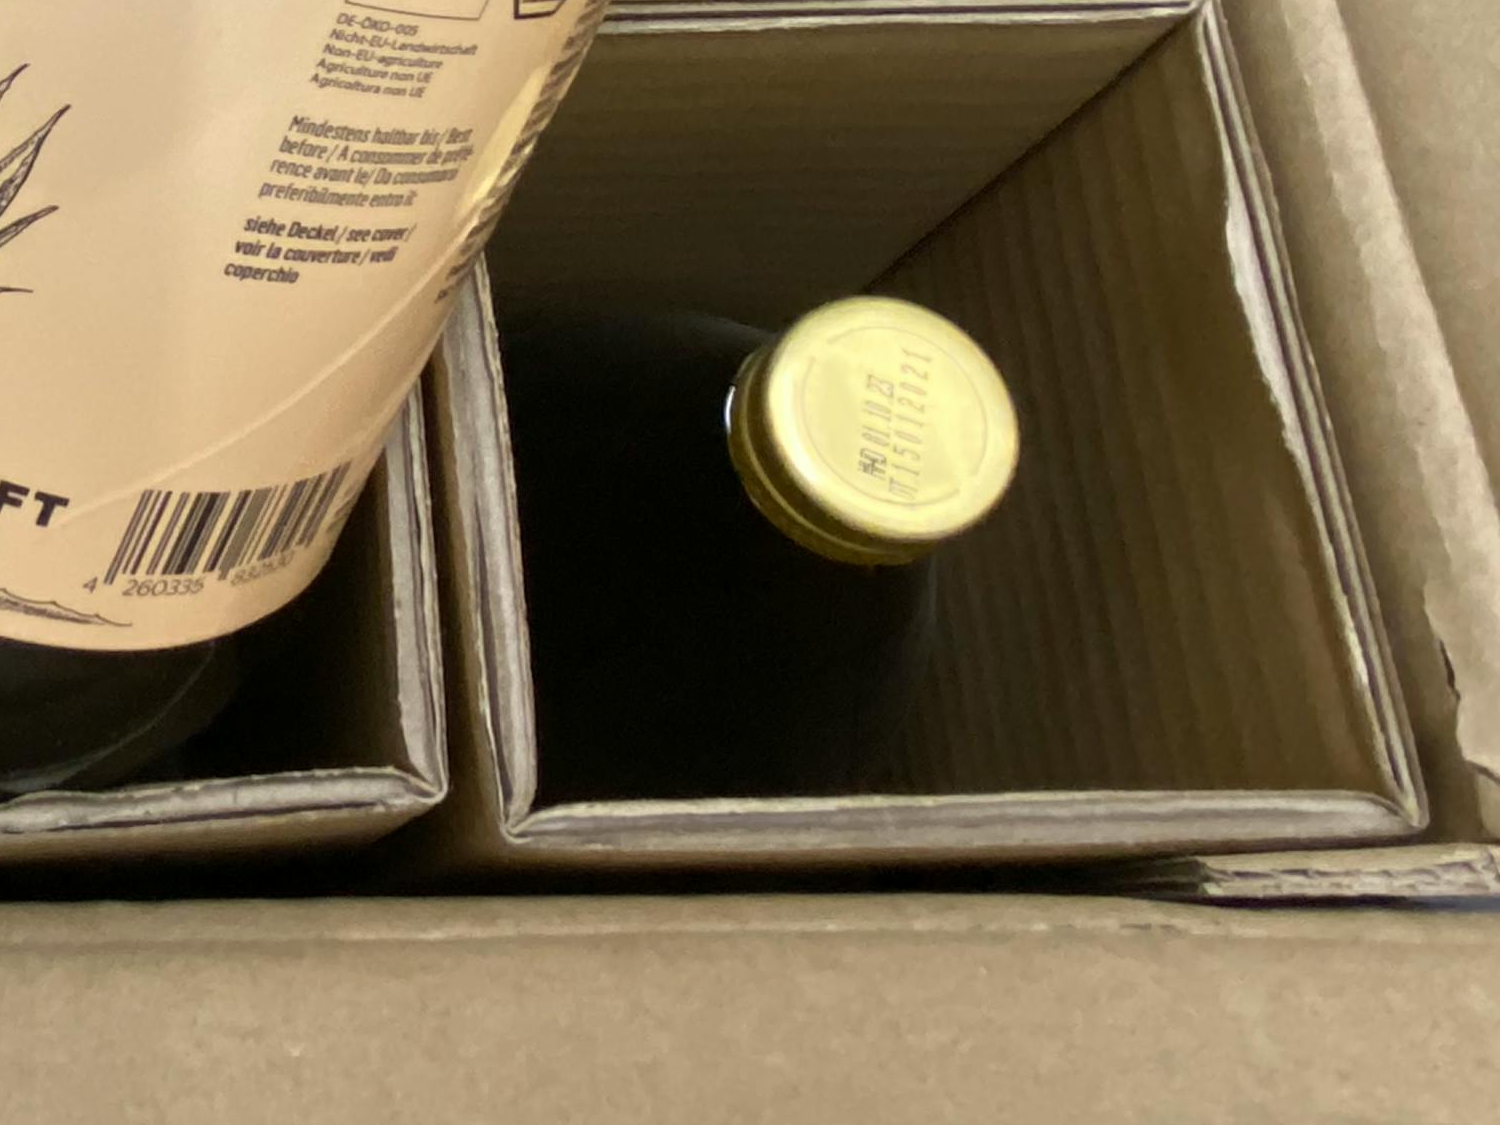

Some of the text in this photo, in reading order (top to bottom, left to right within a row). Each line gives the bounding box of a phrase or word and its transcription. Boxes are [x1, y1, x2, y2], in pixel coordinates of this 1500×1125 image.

[316, 58, 433, 84] Agriculture non UE
[408, 86, 426, 99] UE
[288, 114, 371, 143] Mindestens
[371, 127, 420, 145] haltbar
[279, 135, 328, 159] before
[269, 158, 311, 179] rence
[312, 163, 351, 183] avant
[244, 215, 286, 237] siehe
[286, 220, 338, 242] Deckel
[346, 227, 371, 242] see
[234, 239, 266, 257] voir
[265, 241, 282, 260] la
[282, 245, 360, 264] couverture
[223, 261, 300, 285] coperchio
[82, 575, 98, 594] 4
[121, 576, 206, 597] 260335
